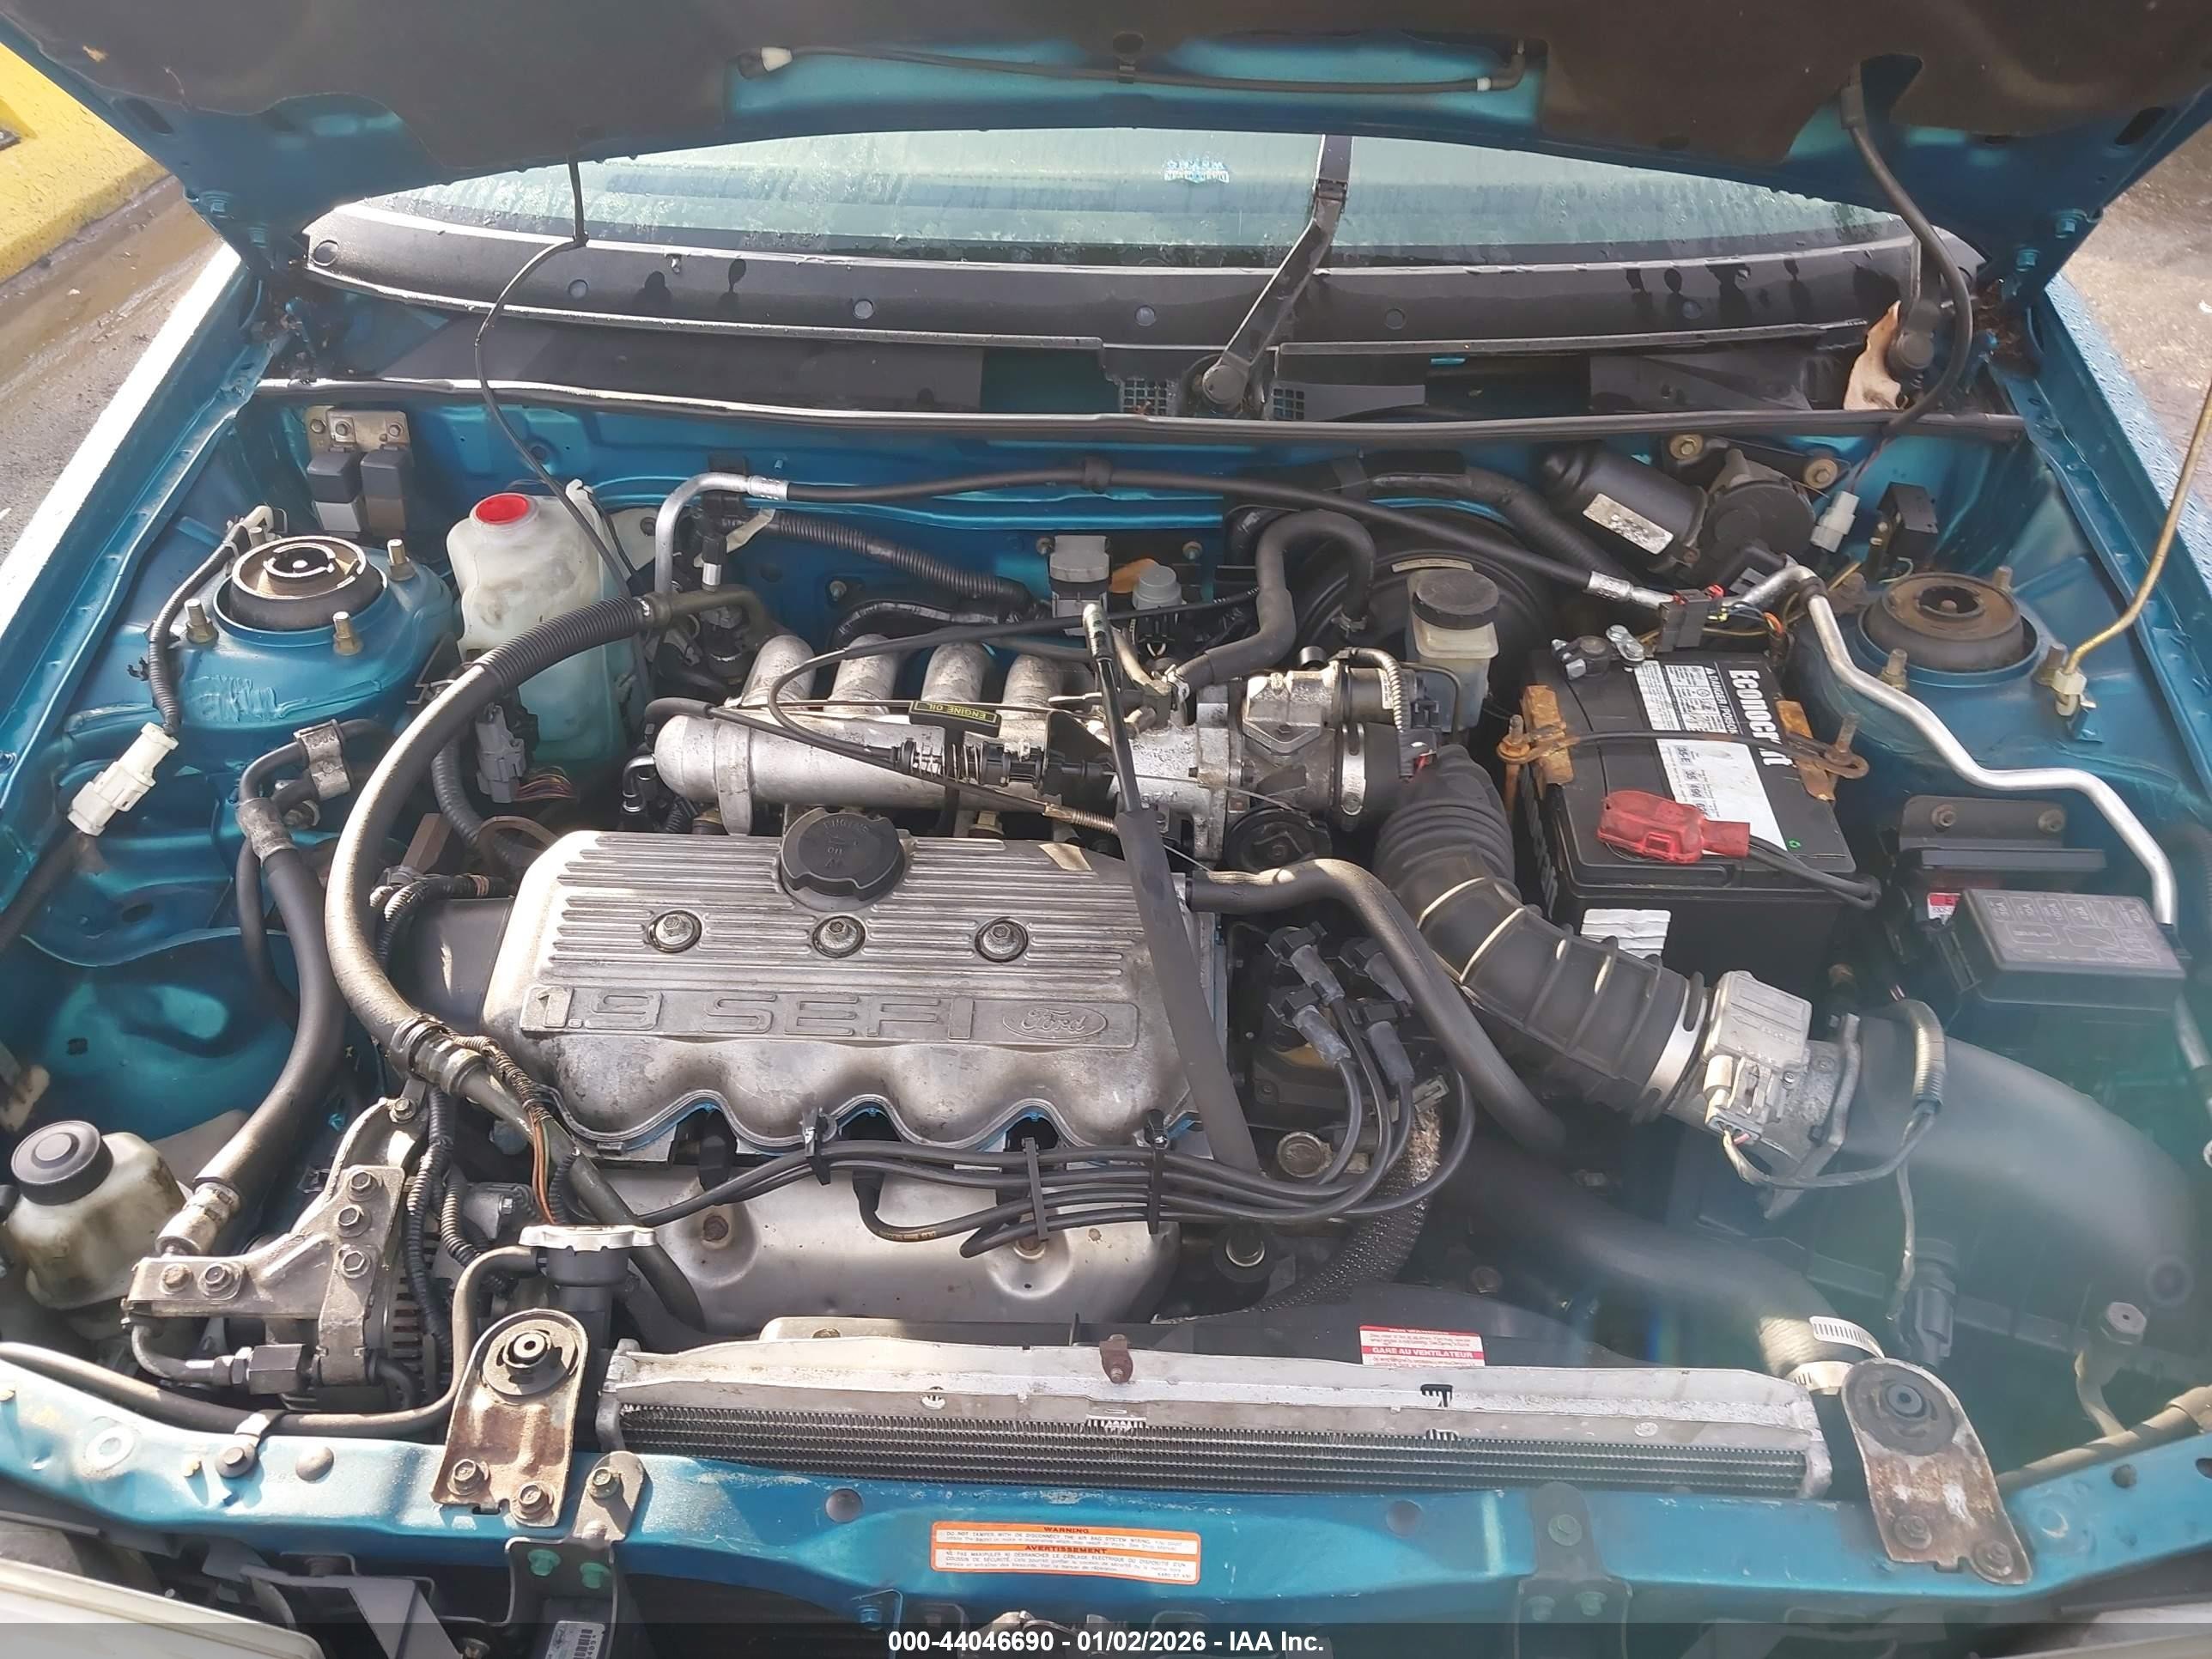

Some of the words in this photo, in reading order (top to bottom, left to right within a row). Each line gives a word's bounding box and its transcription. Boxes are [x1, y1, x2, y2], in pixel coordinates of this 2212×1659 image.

[947, 705, 987, 720] ENGINE
[1728, 670, 1795, 767] Econocrft
[534, 987, 664, 1030] 1.9
[701, 992, 975, 1040] SEFI
[1021, 1007, 1087, 1033] Ford
[1413, 1348, 1474, 1358] VENTILATEUR
[1024, 1545, 1108, 1554] AVERTISSEMENT
